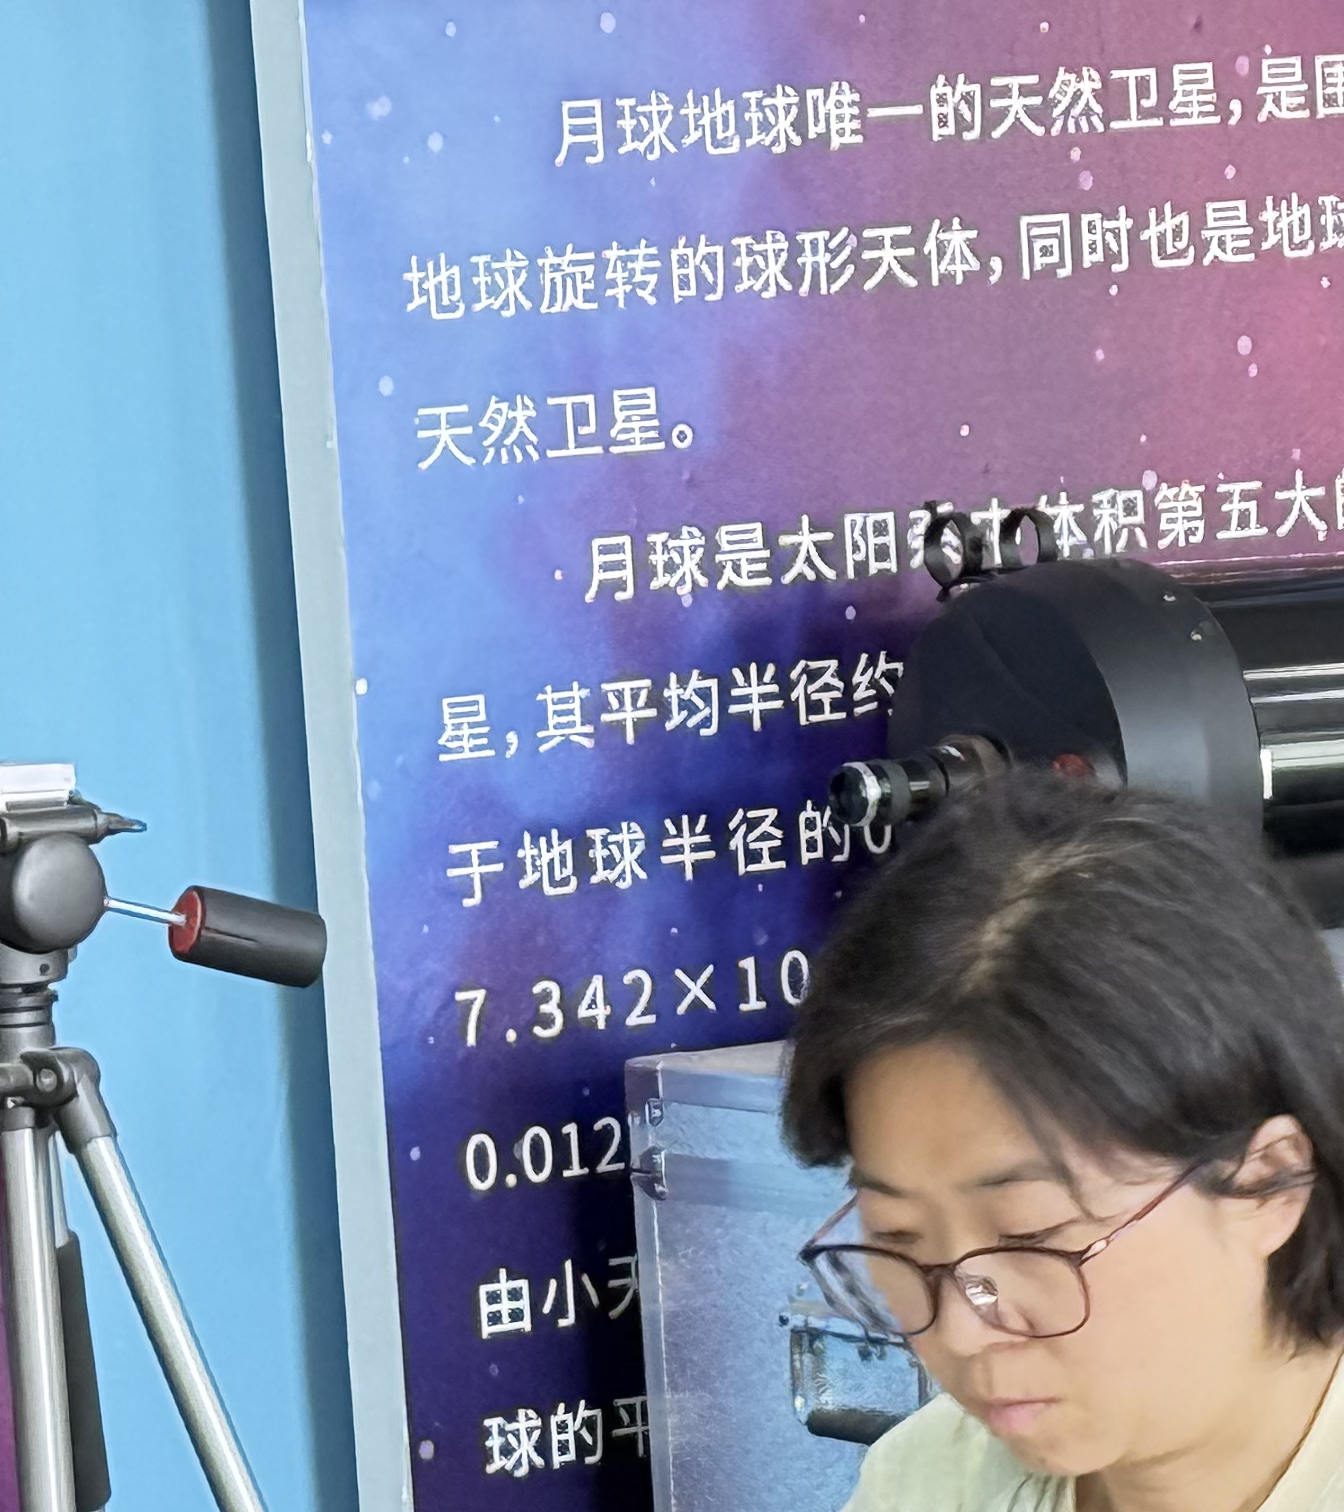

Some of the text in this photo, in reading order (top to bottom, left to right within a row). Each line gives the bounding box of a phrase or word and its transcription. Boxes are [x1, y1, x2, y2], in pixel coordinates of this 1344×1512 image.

[416, 387, 695, 470] 天然卫星。
[466, 1116, 626, 1190] 0.012
